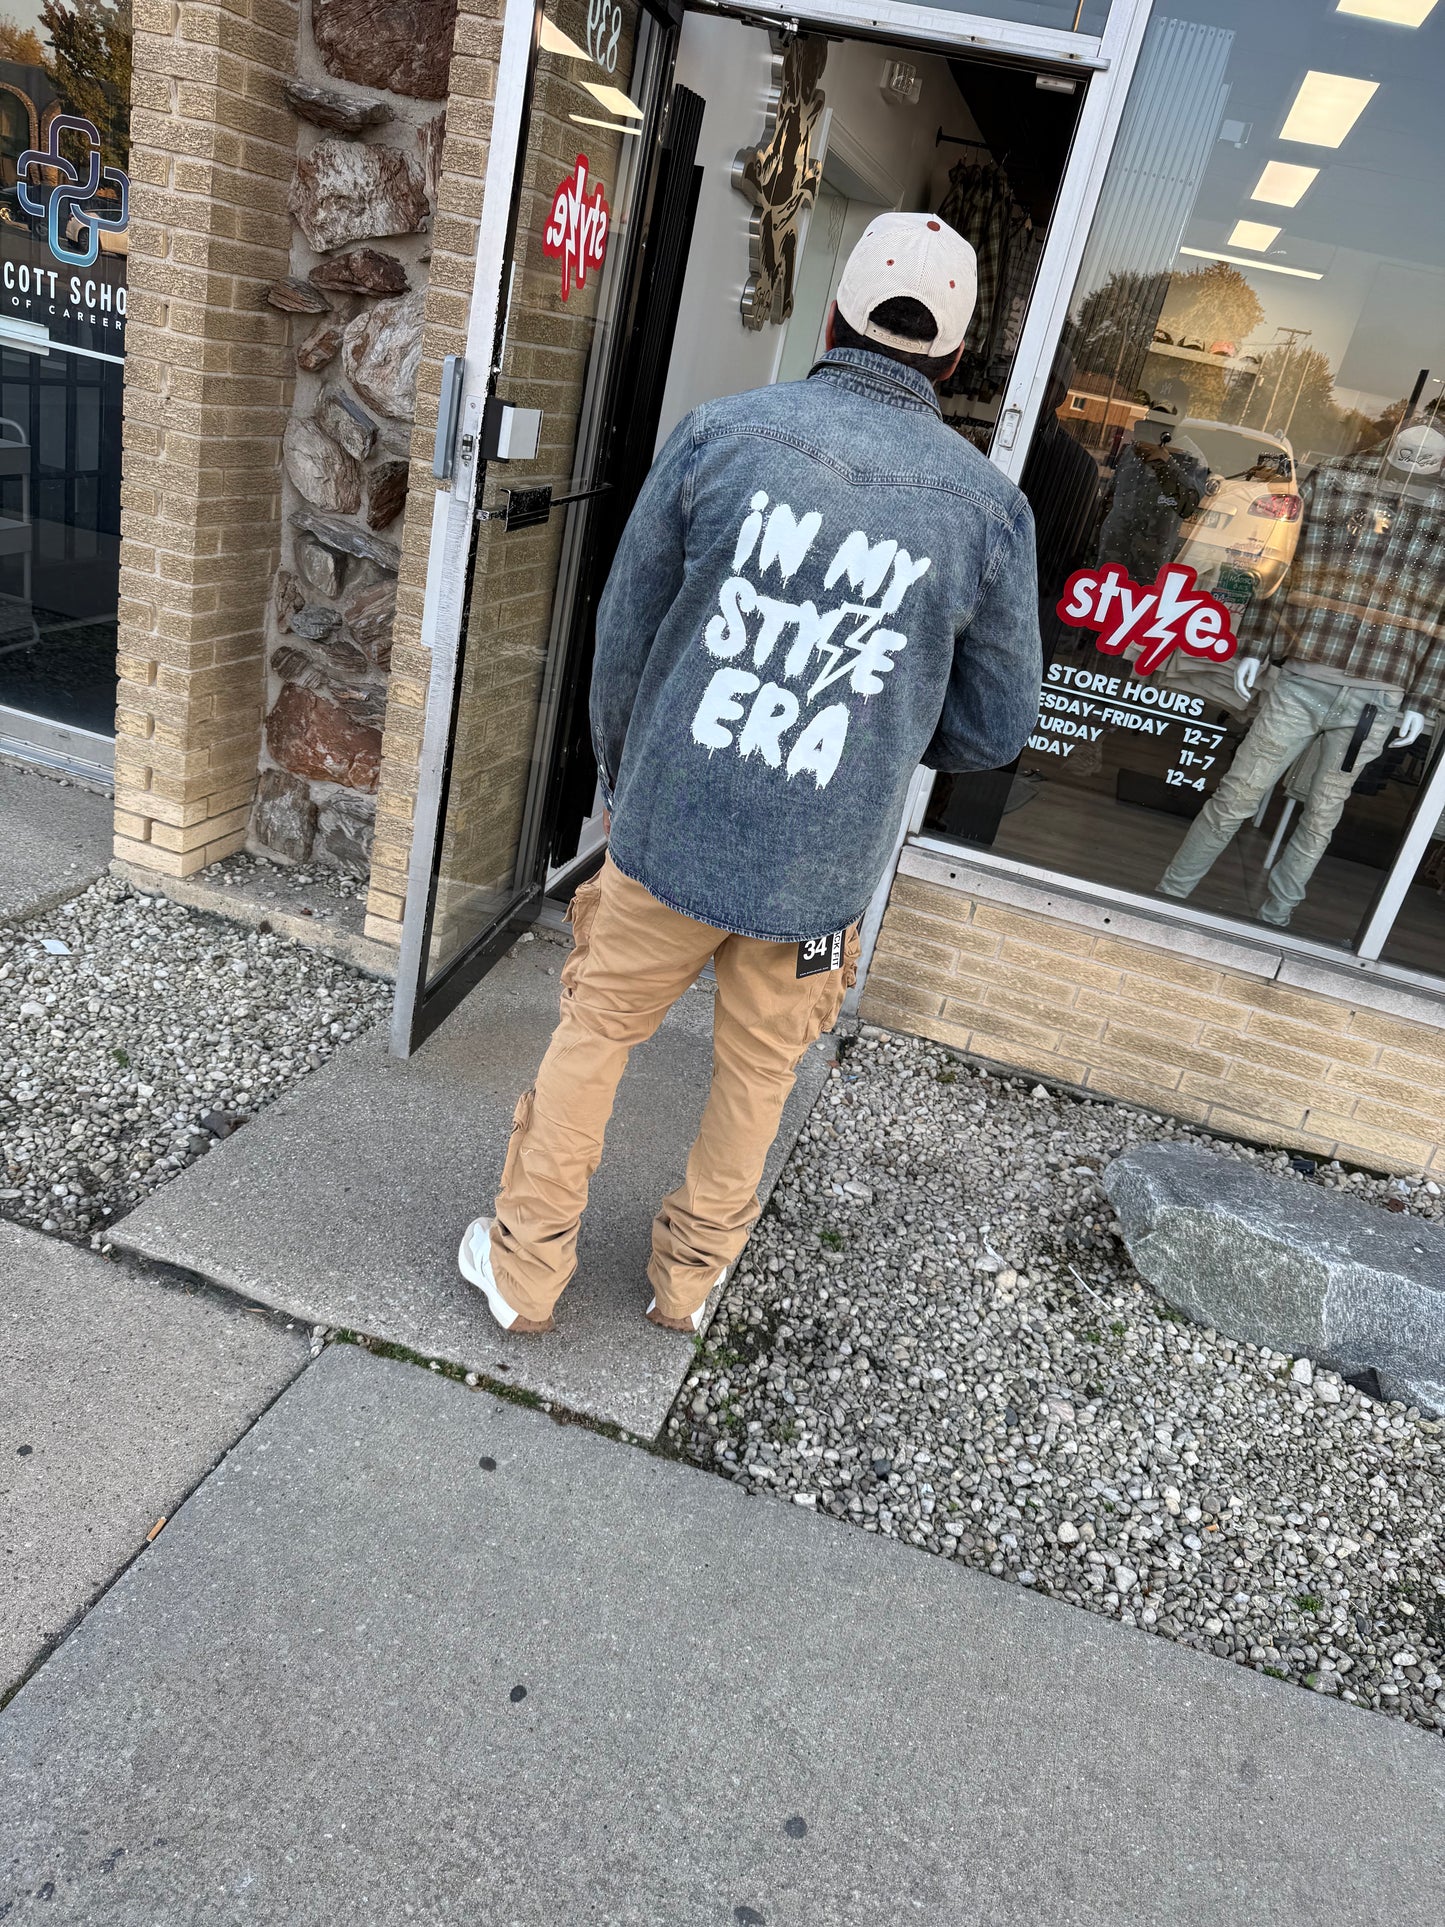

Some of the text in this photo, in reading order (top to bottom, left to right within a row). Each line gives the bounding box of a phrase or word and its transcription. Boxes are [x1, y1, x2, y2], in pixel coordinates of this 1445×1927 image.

[11, 296, 122, 330] OF CAREER
[70, 276, 127, 315] SCHO
[824, 530, 931, 614] MY
[1047, 664, 1205, 716] STORE HOURS
[691, 667, 850, 790] ERA
[1038, 714, 1215, 770] URDAY 11-7
[1182, 728, 1223, 750] 12-7
[1165, 769, 1206, 792] 12-4
[803, 936, 828, 960] 34
